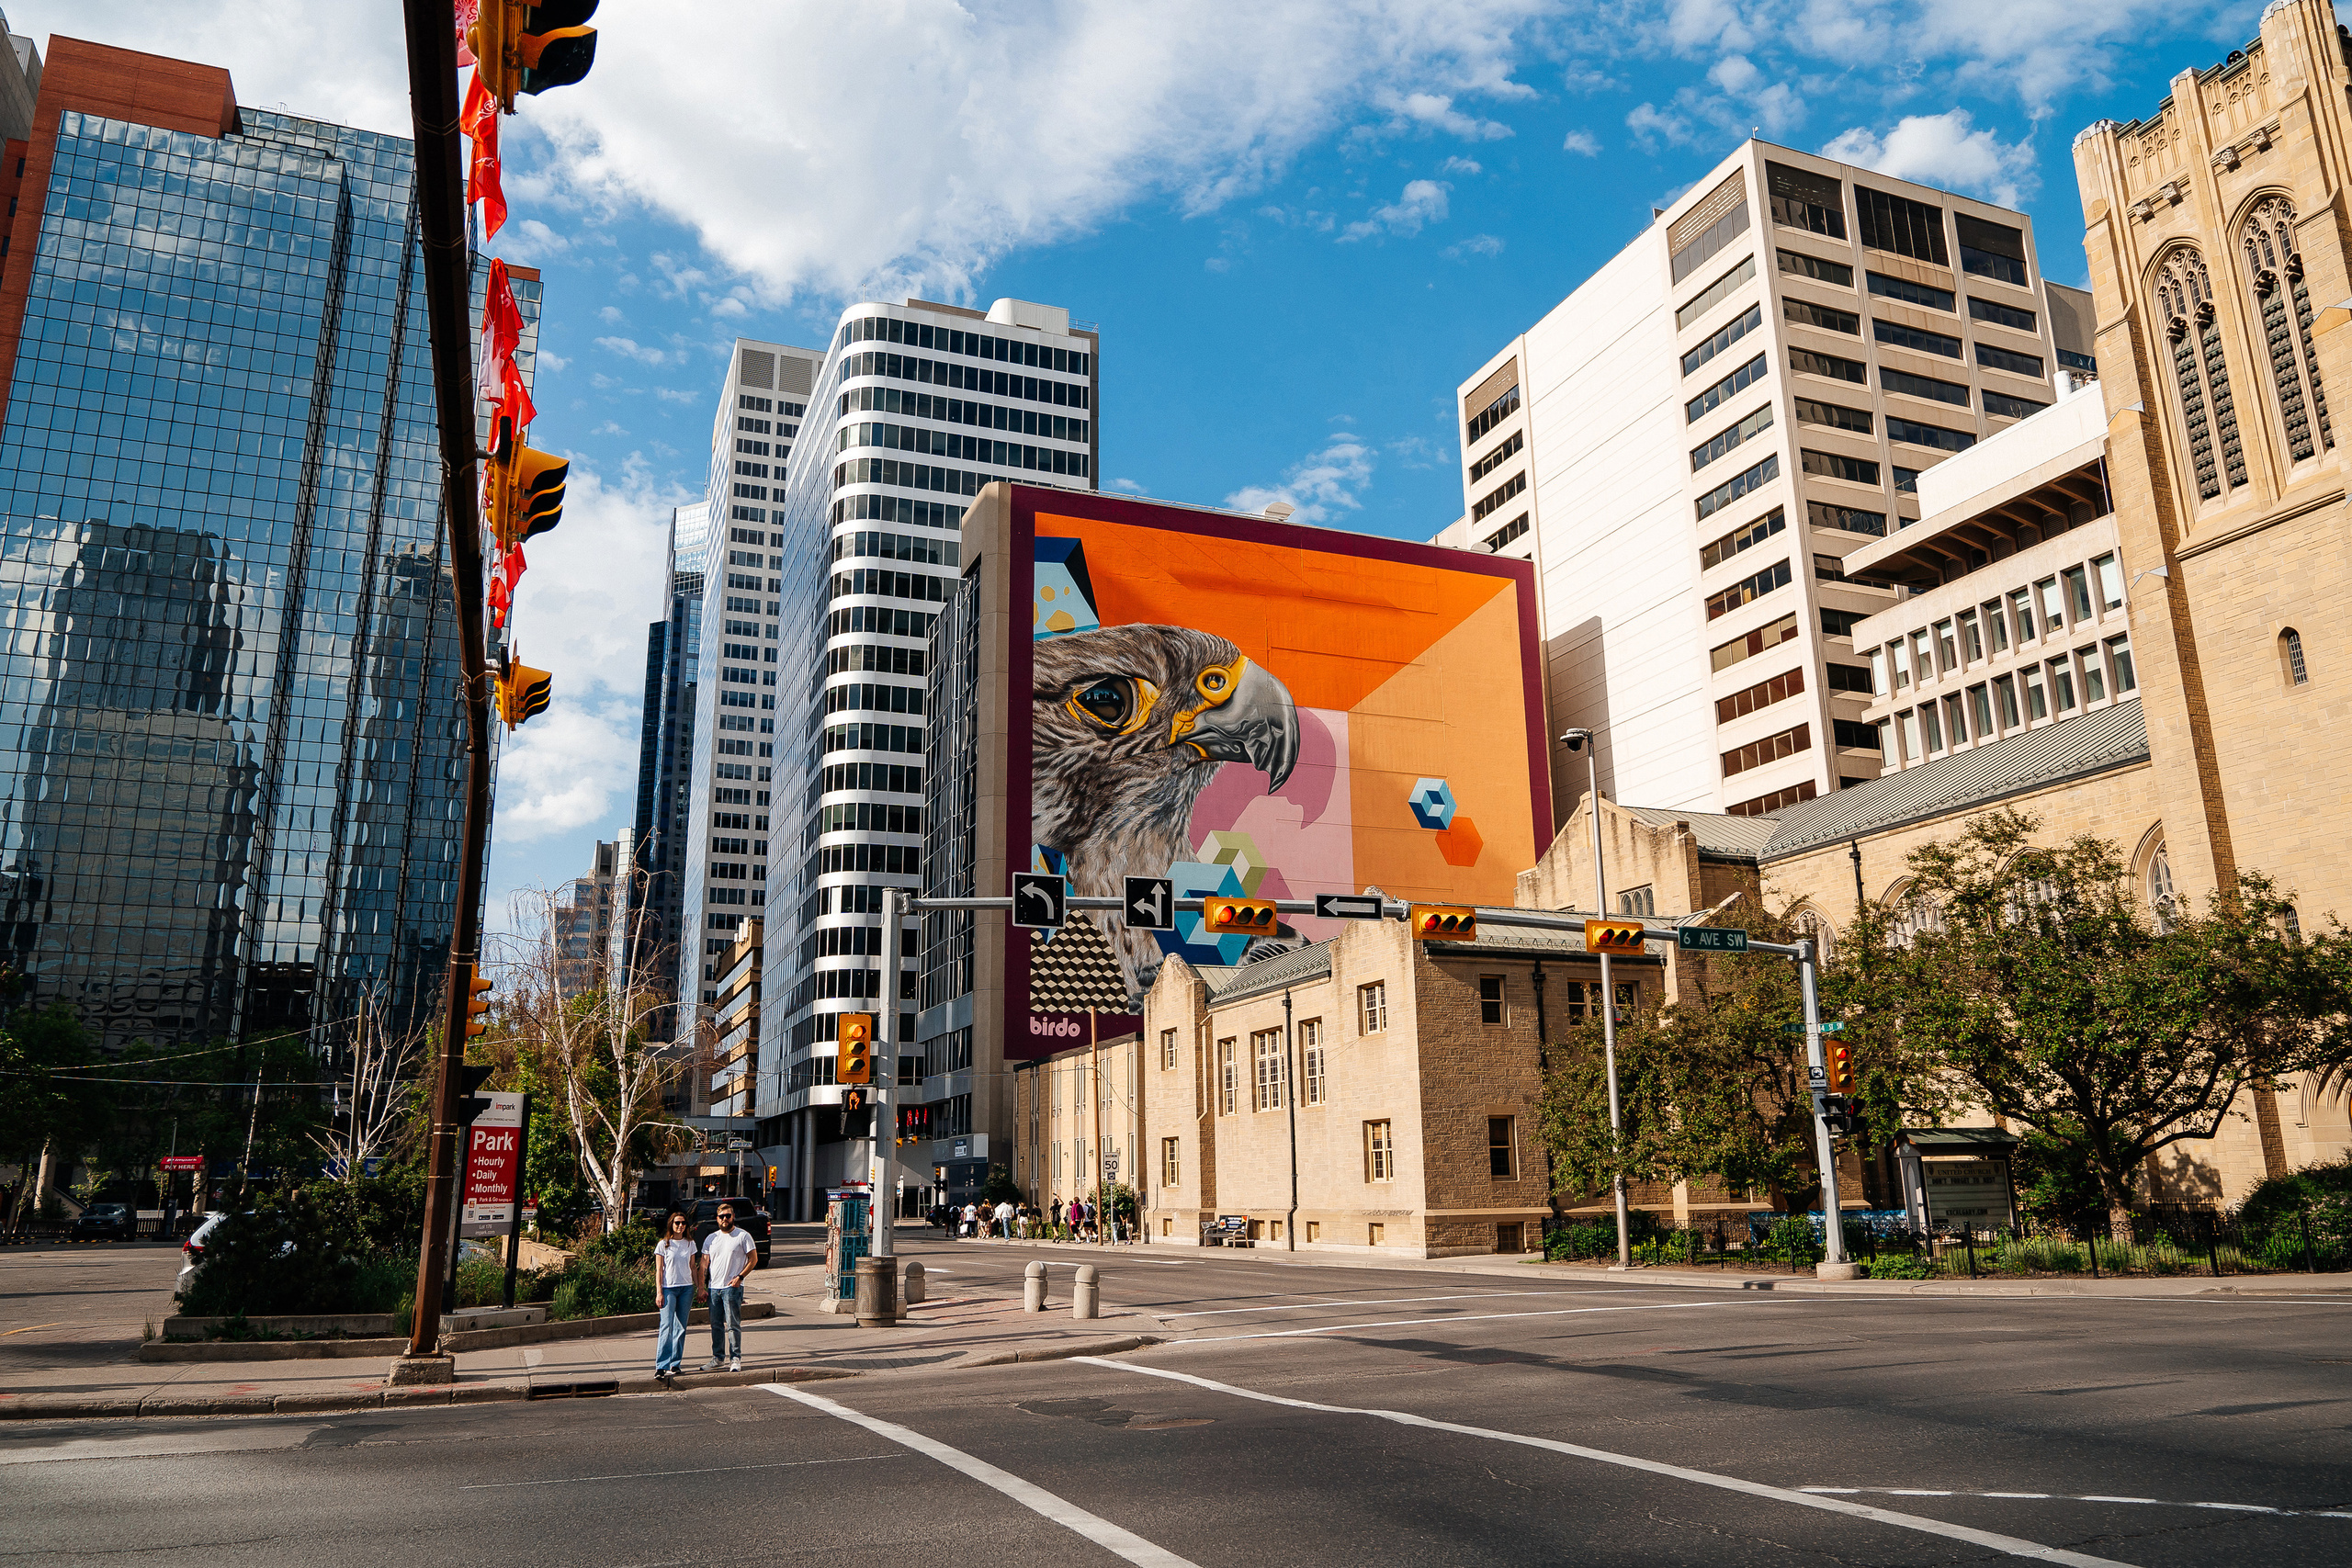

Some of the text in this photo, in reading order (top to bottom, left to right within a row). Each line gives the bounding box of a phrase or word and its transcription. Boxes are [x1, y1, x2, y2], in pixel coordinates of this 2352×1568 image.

[1683, 932, 1744, 947] 6 AVE SW
[1030, 1016, 1080, 1037] birdo
[495, 1102, 515, 1111] impark
[473, 1131, 514, 1151] Park
[478, 1156, 505, 1168] Hourly
[1104, 1160, 1118, 1169] 50
[476, 1169, 497, 1181] Daily
[474, 1183, 508, 1195] Monthly
